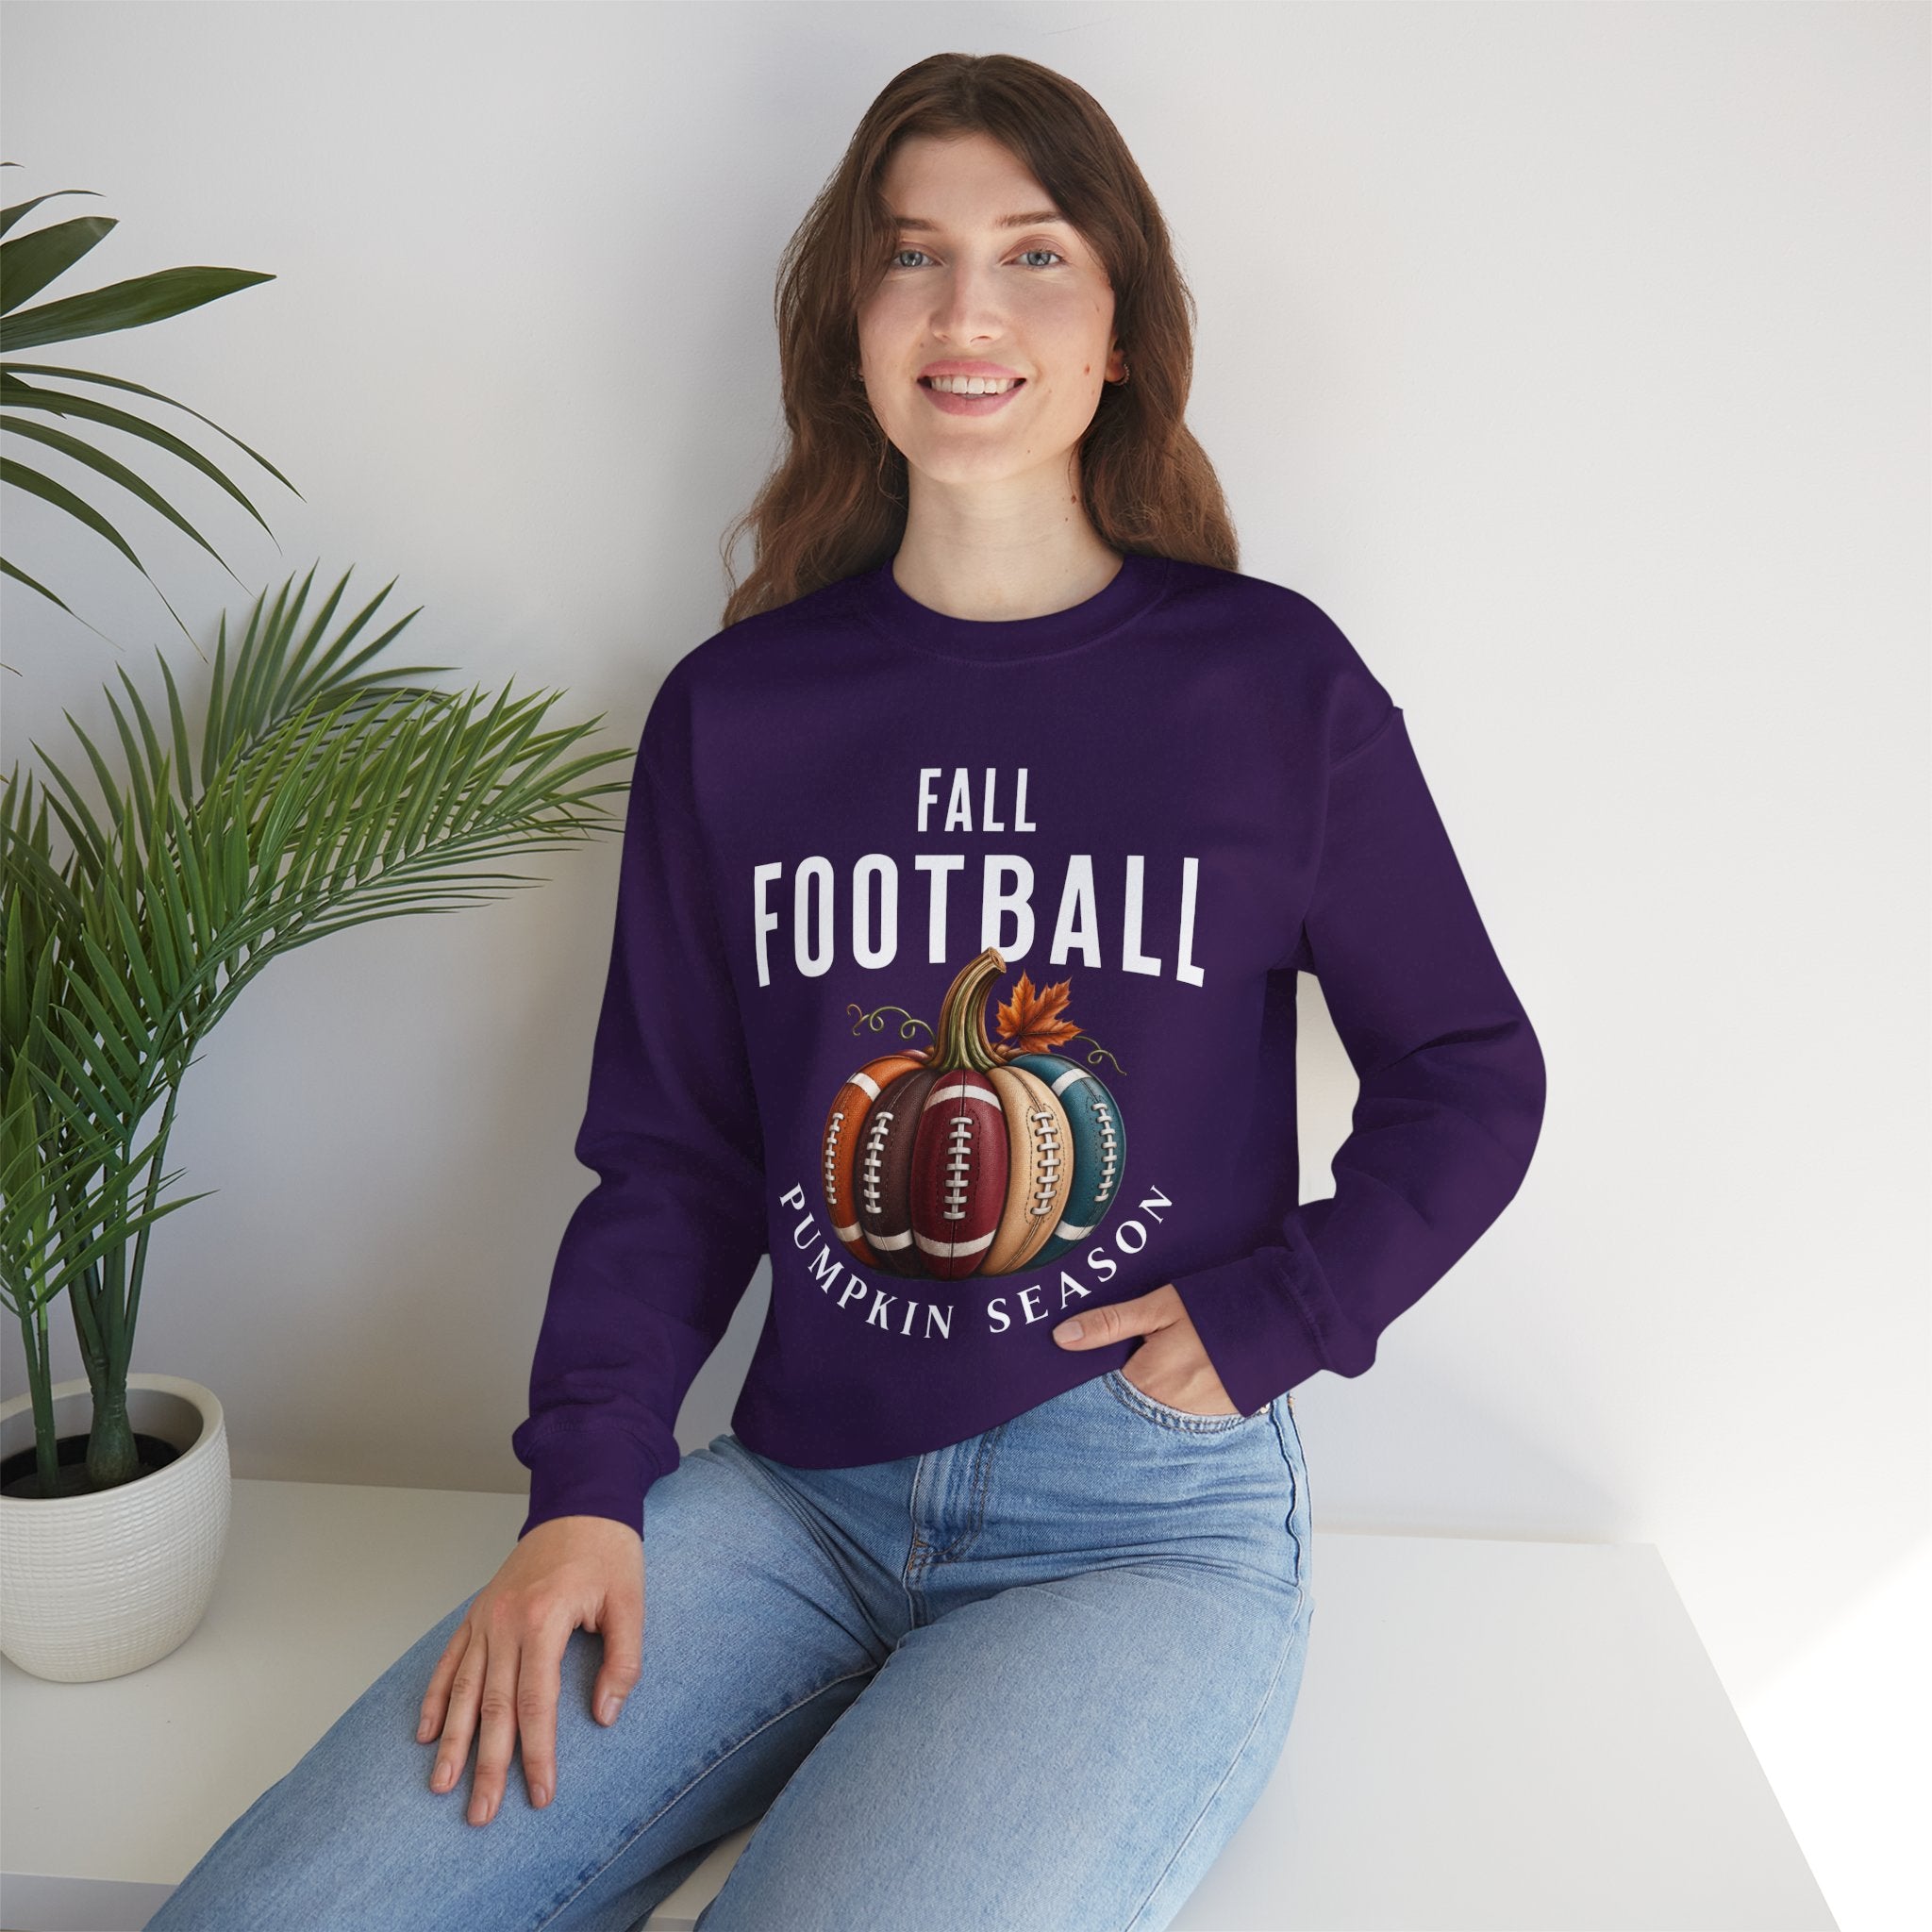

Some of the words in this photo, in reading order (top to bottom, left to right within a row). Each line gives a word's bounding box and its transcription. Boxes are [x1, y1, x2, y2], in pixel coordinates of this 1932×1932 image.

[917, 767, 1037, 832] FALL
[754, 853, 1205, 988] FOOTBALL
[779, 1182, 955, 1340] PUMPKIN
[987, 1184, 1174, 1334] SEASON
